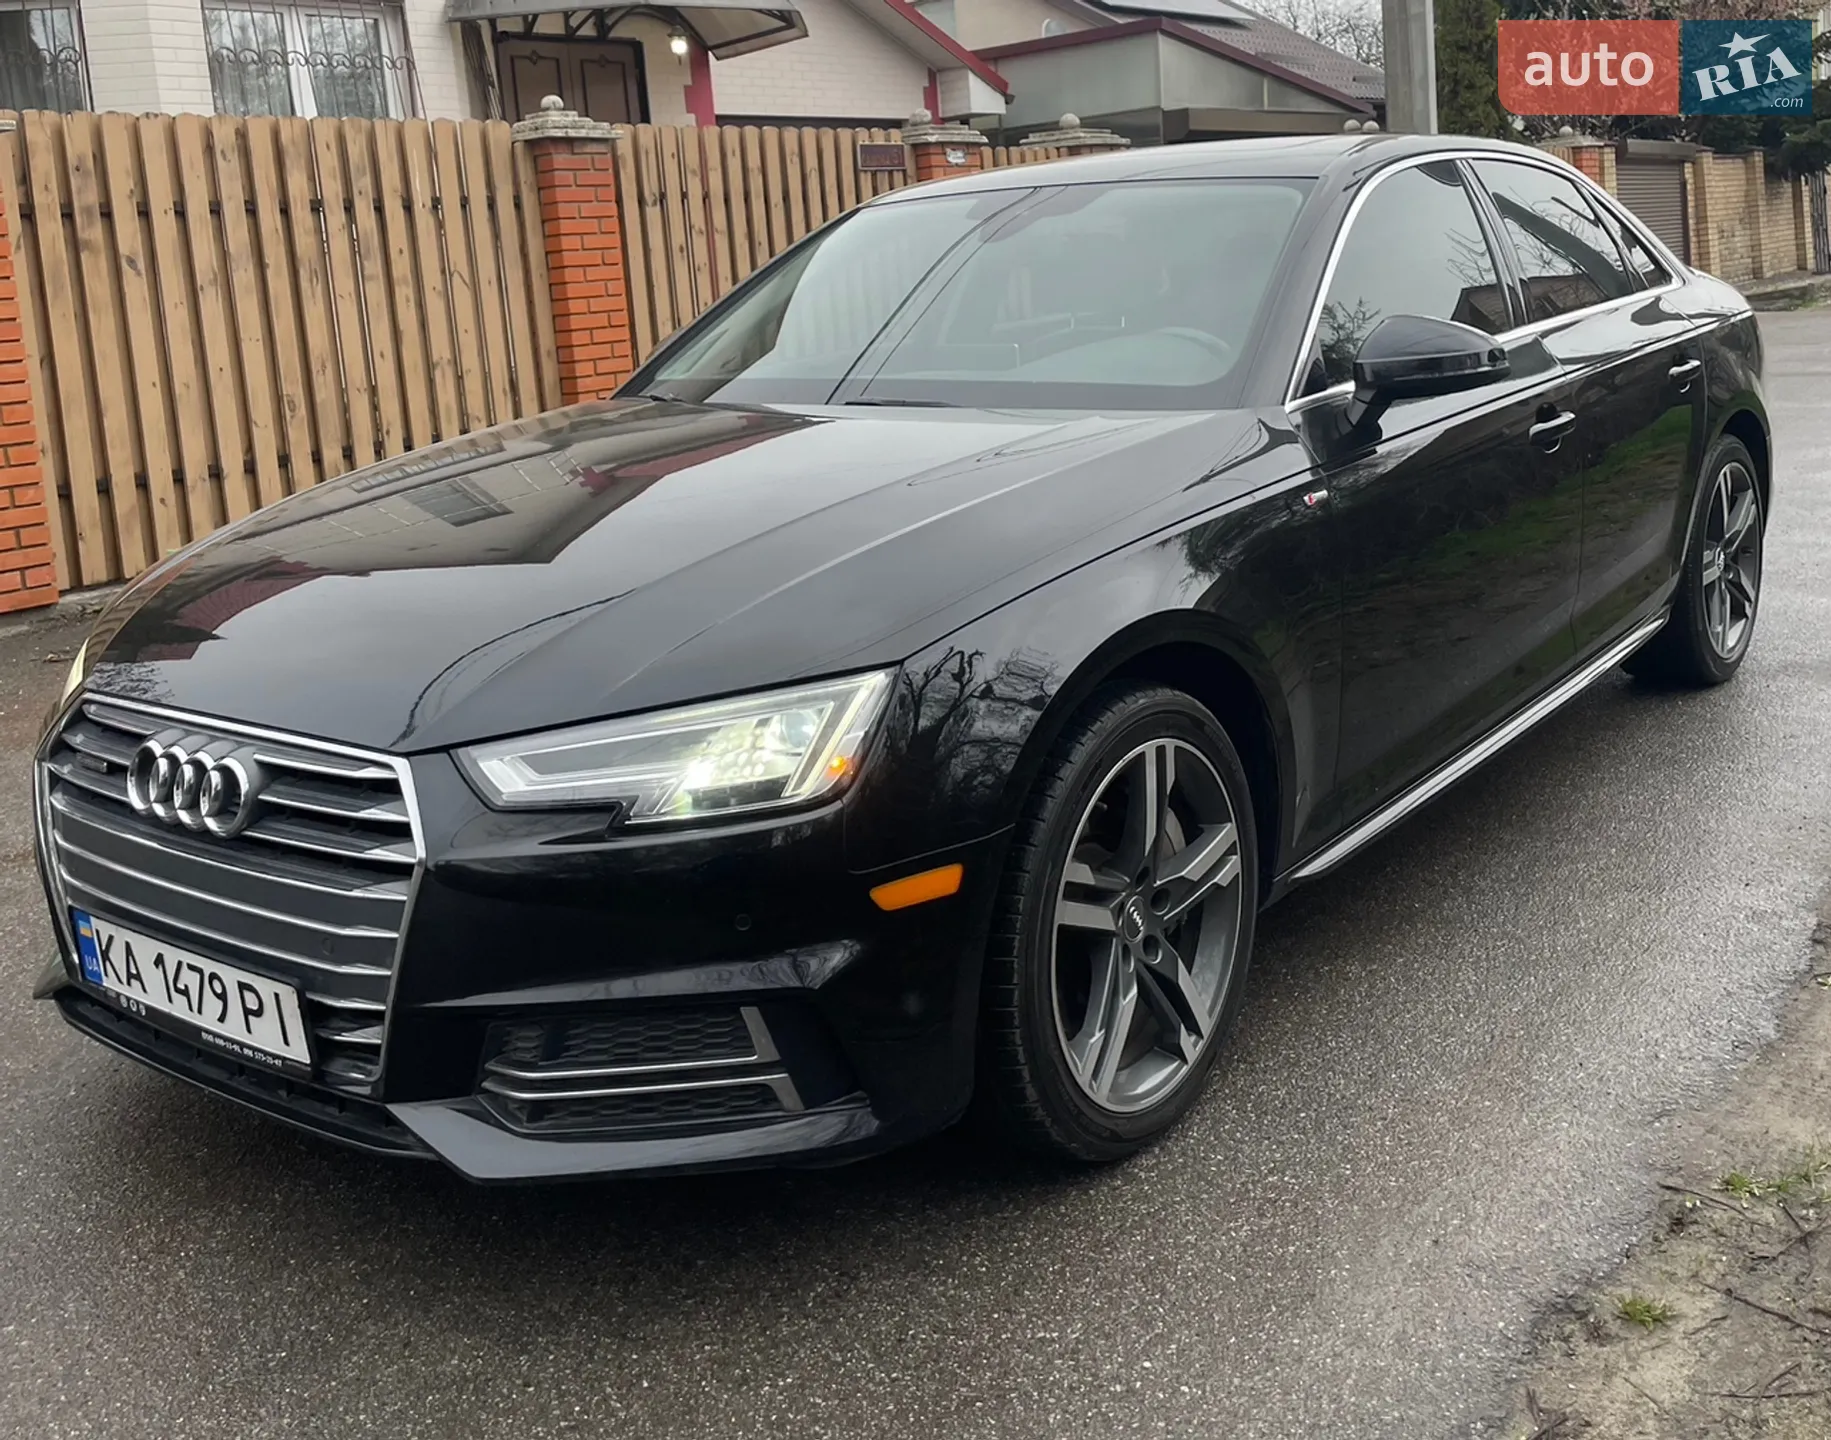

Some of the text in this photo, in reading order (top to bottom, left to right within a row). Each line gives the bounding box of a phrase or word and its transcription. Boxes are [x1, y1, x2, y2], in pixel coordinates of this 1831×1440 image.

[84, 956, 99, 974] UA
[94, 928, 291, 1047] KA 1479 PI
